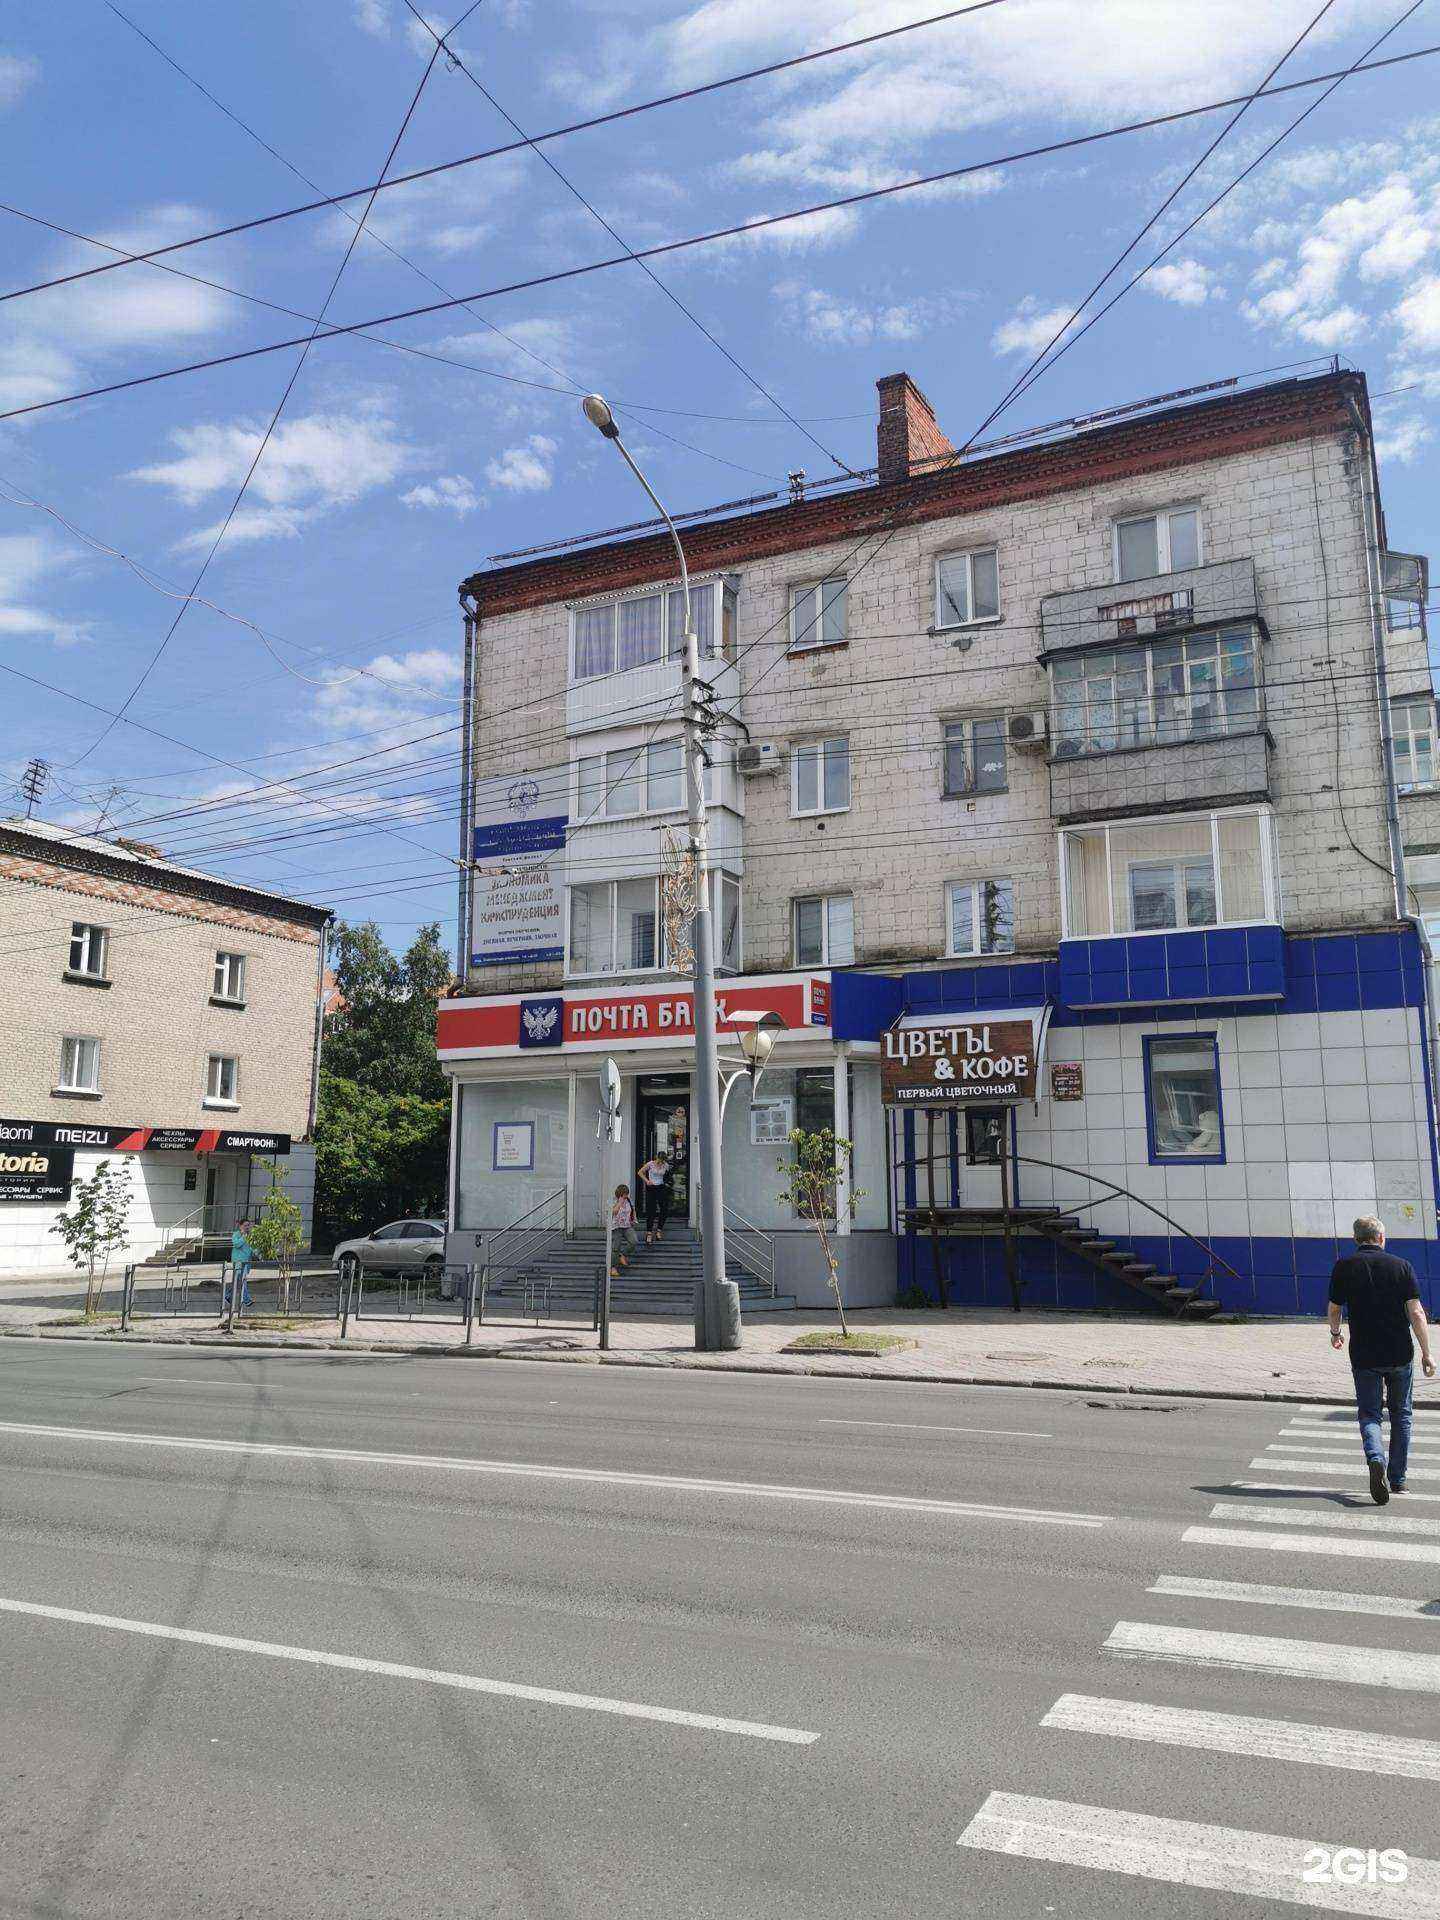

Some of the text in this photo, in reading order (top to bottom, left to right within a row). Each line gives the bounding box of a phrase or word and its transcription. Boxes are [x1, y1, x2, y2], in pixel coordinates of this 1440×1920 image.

[571, 998, 729, 1033] ПОЧТА БАК
[883, 1026, 994, 1067] ЦВЕТЫ
[934, 1055, 1029, 1080] & КОФЕ
[898, 1082, 1018, 1099] ПЕРВЫЙ ЦВЕТОЧНЫЙ
[227, 1136, 279, 1149] СМАРТФОНЫ
